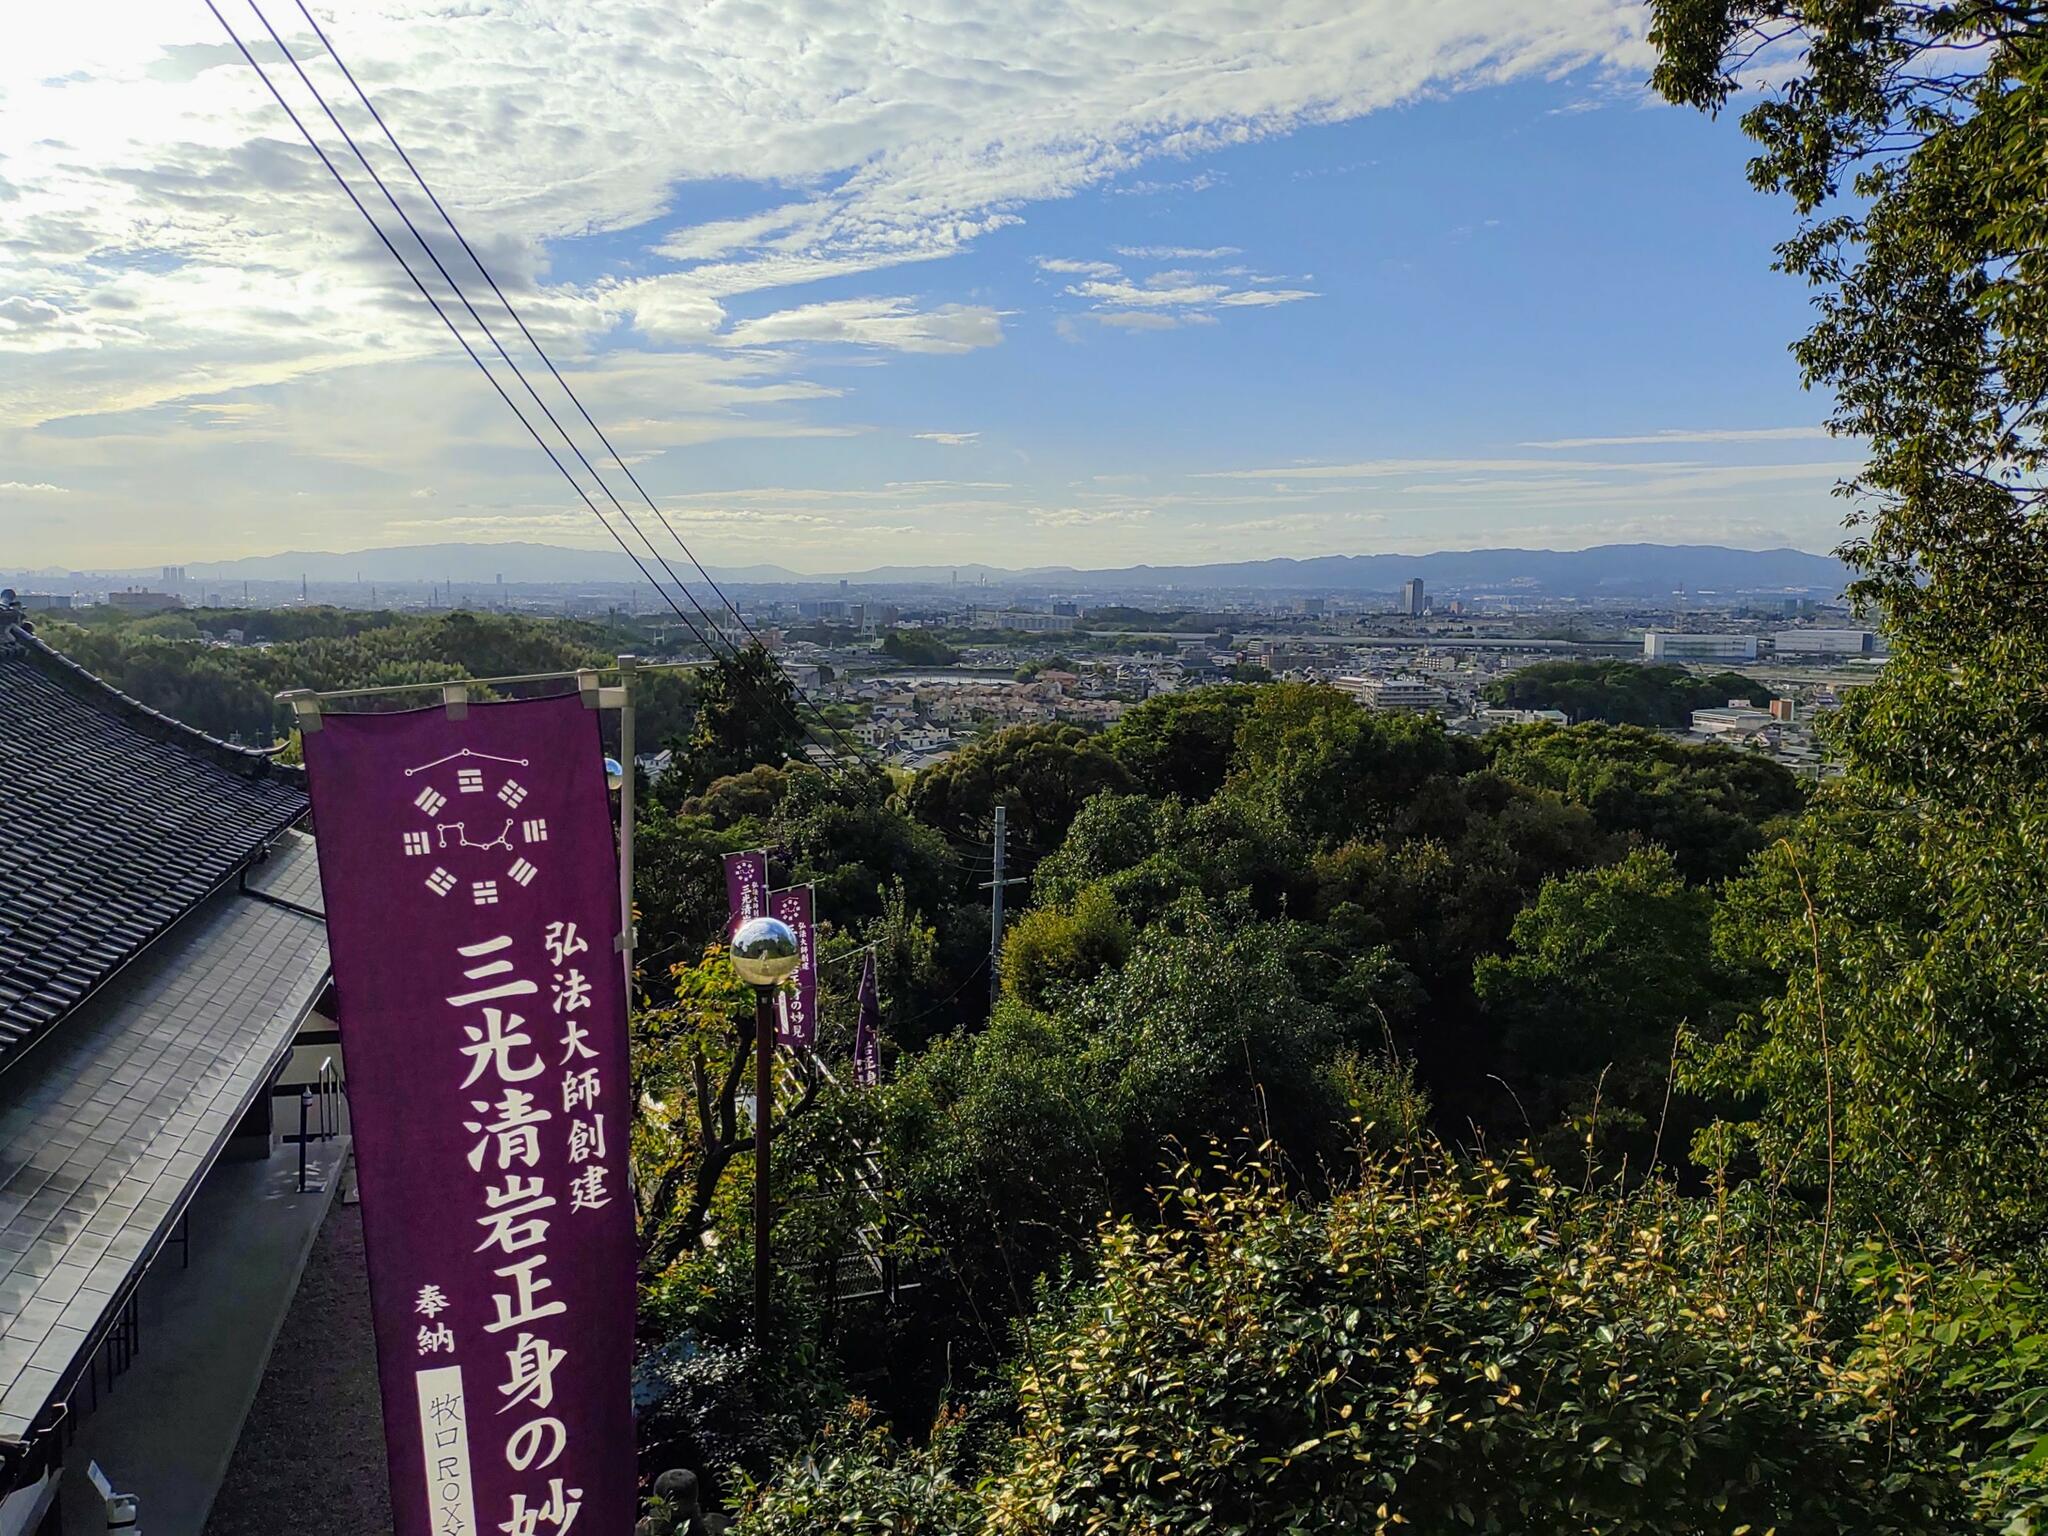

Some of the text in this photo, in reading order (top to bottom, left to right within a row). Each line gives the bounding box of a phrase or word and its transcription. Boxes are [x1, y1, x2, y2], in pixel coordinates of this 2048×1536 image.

[545, 920, 612, 1214] 弘法大師創建
[414, 1284, 455, 1356] 奉納
[446, 935, 584, 1536] 三光清岩正身の妙
